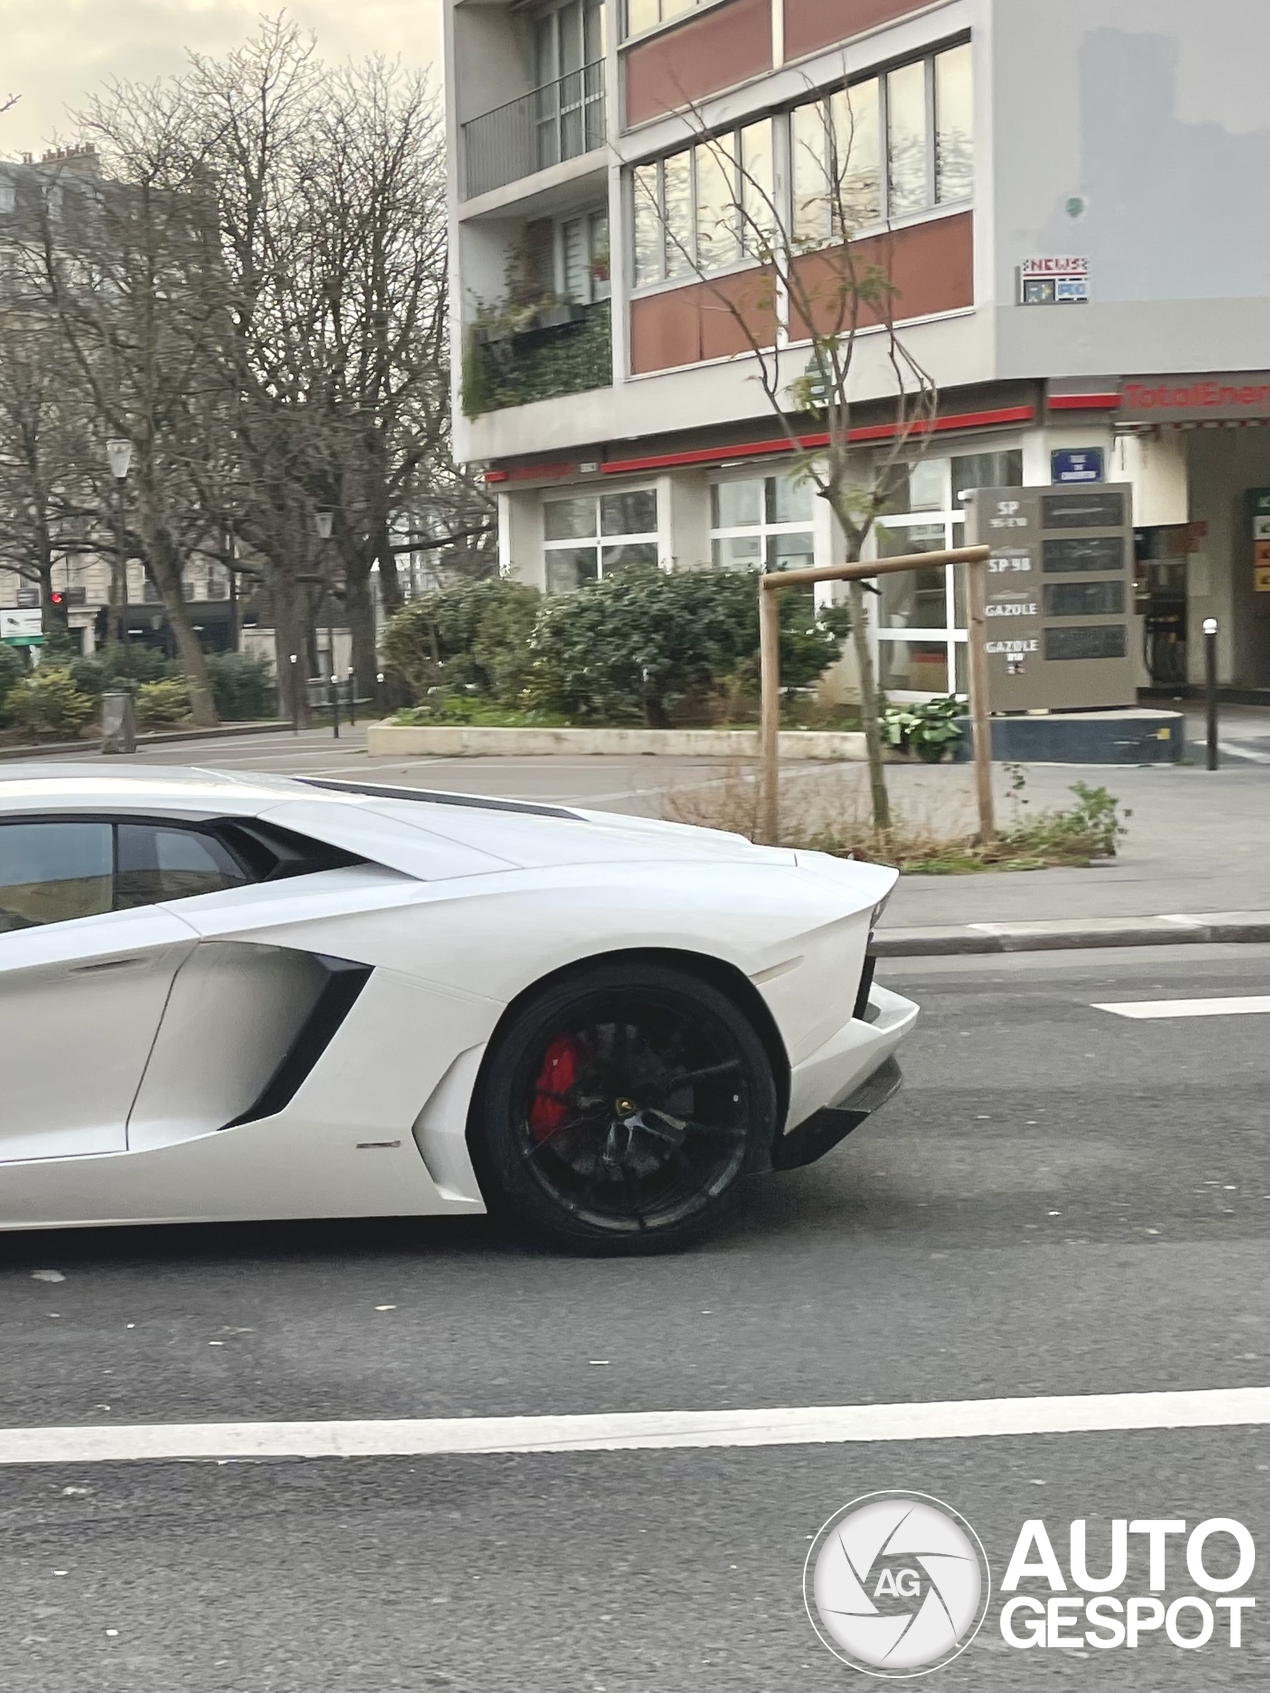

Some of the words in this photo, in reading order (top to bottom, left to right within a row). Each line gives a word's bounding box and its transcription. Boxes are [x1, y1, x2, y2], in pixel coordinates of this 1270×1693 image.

[1031, 258, 1079, 271] NEWS
[996, 501, 1020, 515] SP
[985, 602, 1039, 617] GAZOLE
[985, 640, 1040, 653] GAZOLE
